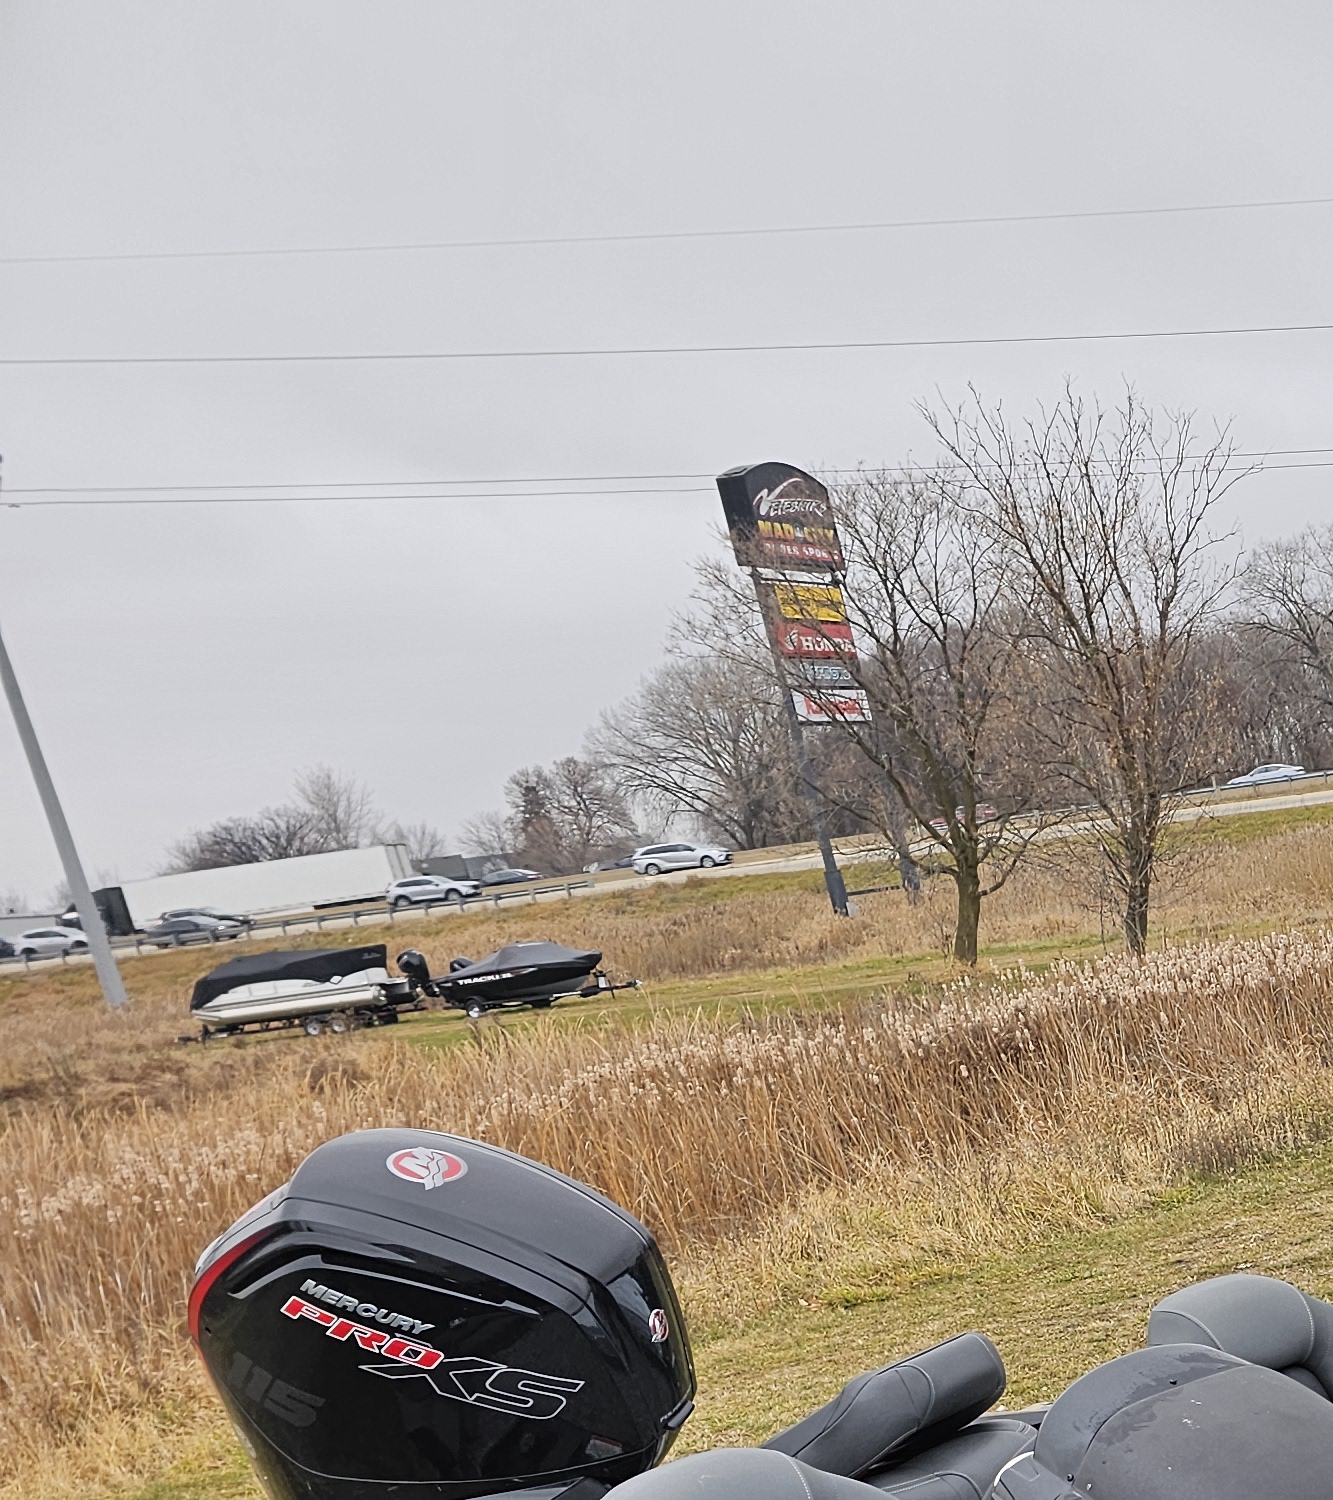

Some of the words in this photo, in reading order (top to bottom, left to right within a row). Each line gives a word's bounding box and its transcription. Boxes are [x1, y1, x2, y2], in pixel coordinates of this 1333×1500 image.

[758, 520, 794, 540] MAD
[802, 546, 839, 559] SPORS
[280, 1295, 445, 1370] PRO
[300, 1279, 436, 1335] MERCURY
[227, 1350, 327, 1427] 115
[358, 1356, 586, 1420] XS
